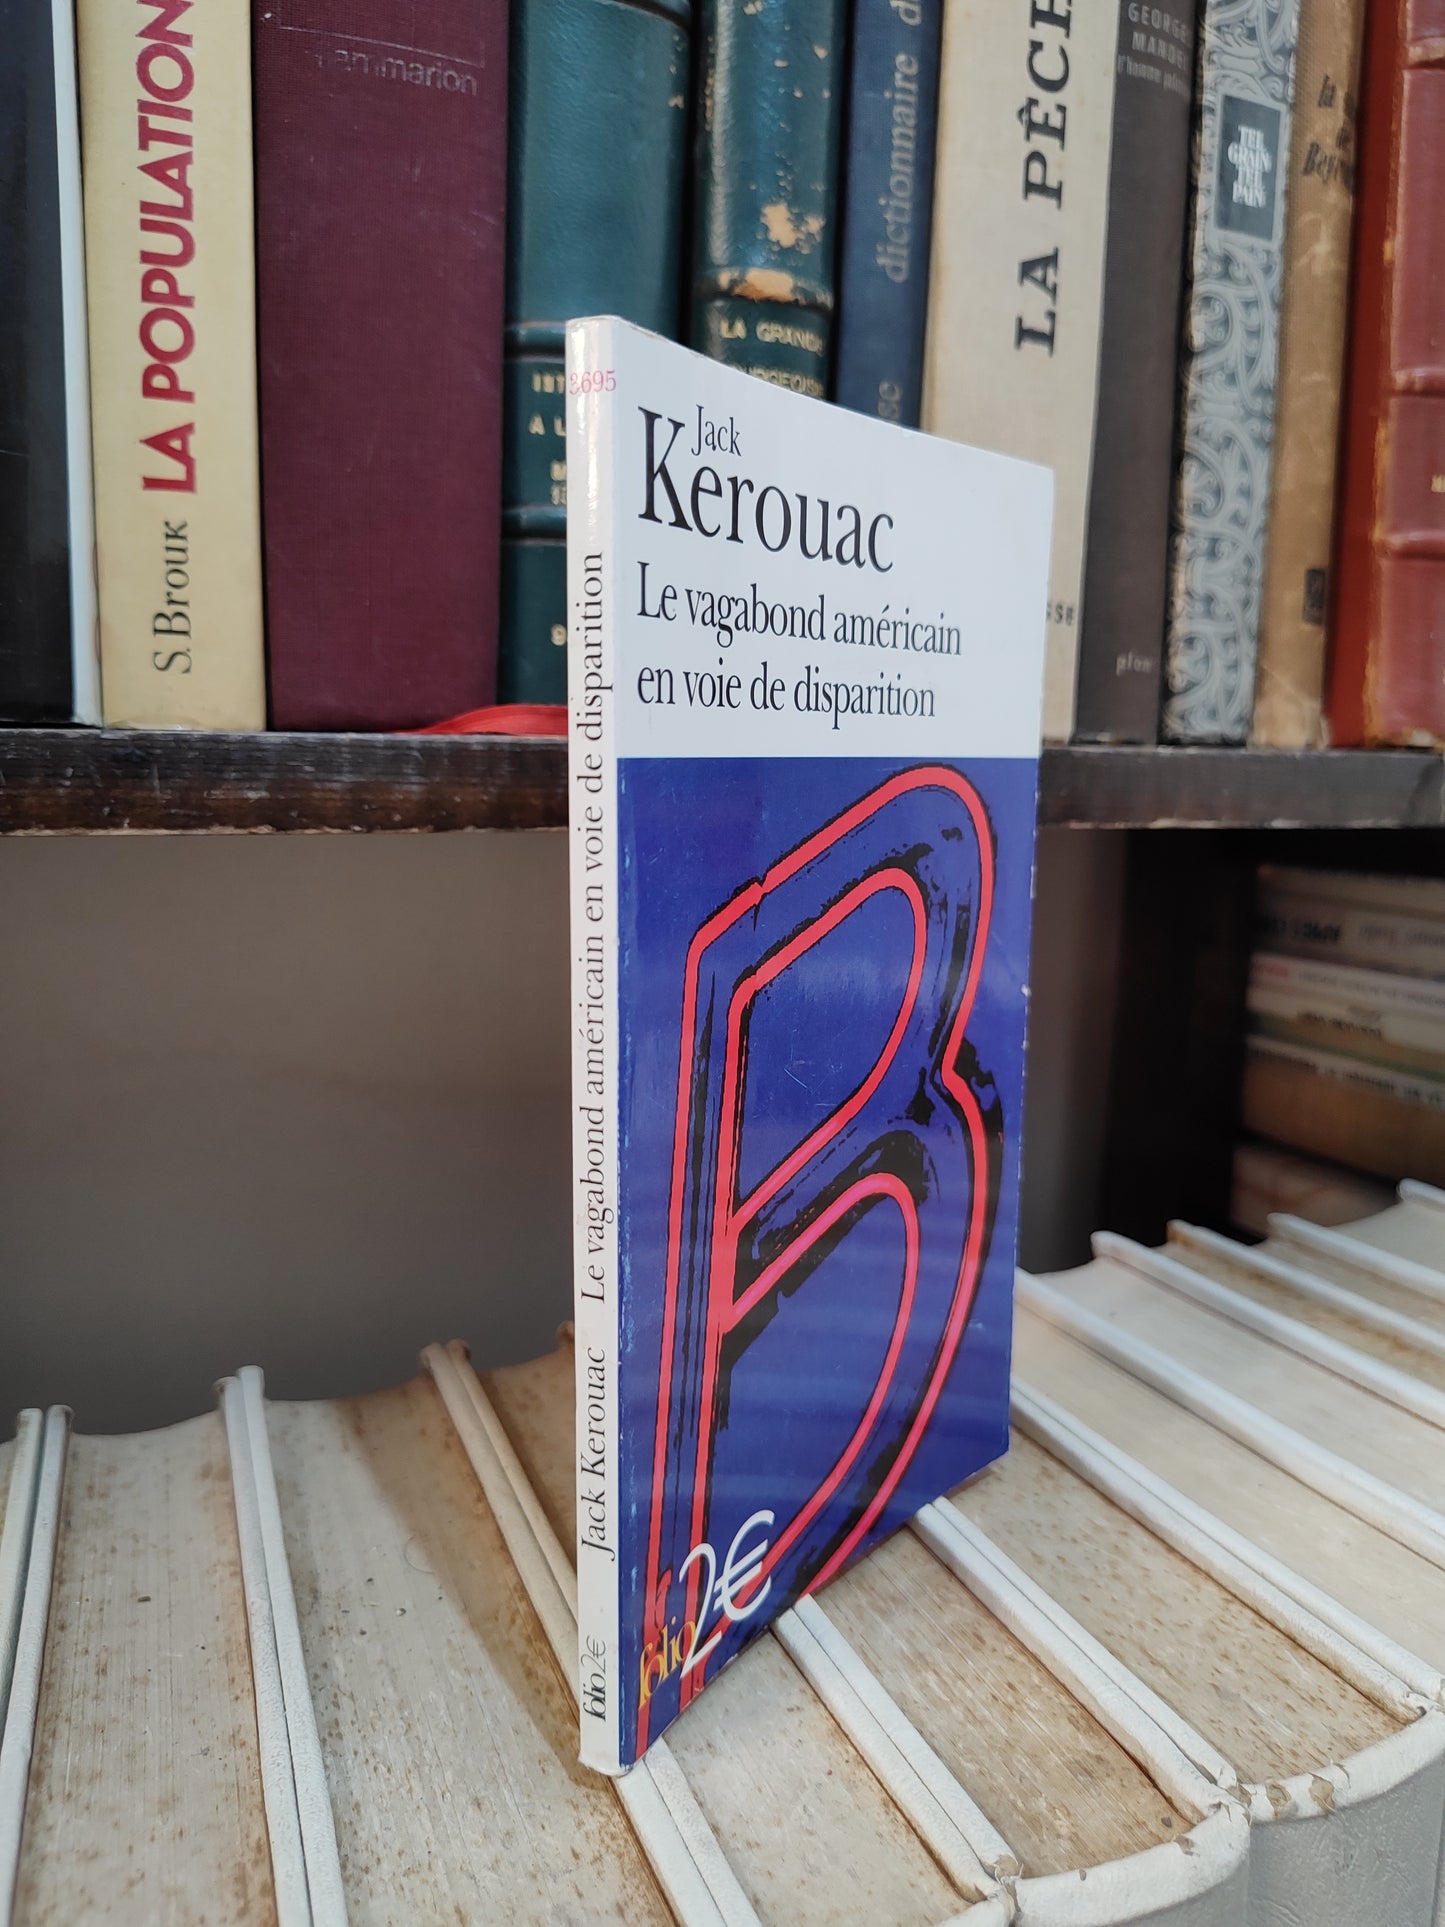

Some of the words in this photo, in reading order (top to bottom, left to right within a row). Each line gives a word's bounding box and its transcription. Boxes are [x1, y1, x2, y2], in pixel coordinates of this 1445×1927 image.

[136, 0, 195, 402] POPULATION
[876, 53, 918, 283] dictionnaire
[720, 318, 746, 340] LA
[756, 321, 823, 357] GRAND
[1015, 248, 1060, 356] LA
[569, 370, 616, 395] 3695
[139, 422, 197, 492] LA
[691, 404, 742, 456] Jack
[637, 406, 894, 573] Kerouac
[637, 561, 678, 621] Le
[685, 583, 826, 648] vagabond
[833, 604, 962, 655] américain
[154, 650, 191, 674] S.
[575, 553, 614, 741] disparition
[637, 666, 676, 704] en
[683, 657, 742, 706] voie
[750, 662, 786, 711] de
[794, 666, 935, 730] disparition
[577, 753, 602, 793] de
[577, 805, 603, 872] voie
[585, 884, 603, 922] en
[579, 935, 604, 1095] américain
[580, 1106, 615, 1256] vagabond
[581, 1264, 604, 1303] Le
[581, 1347, 606, 1480] Kerouac
[581, 1489, 615, 1562] Jack
